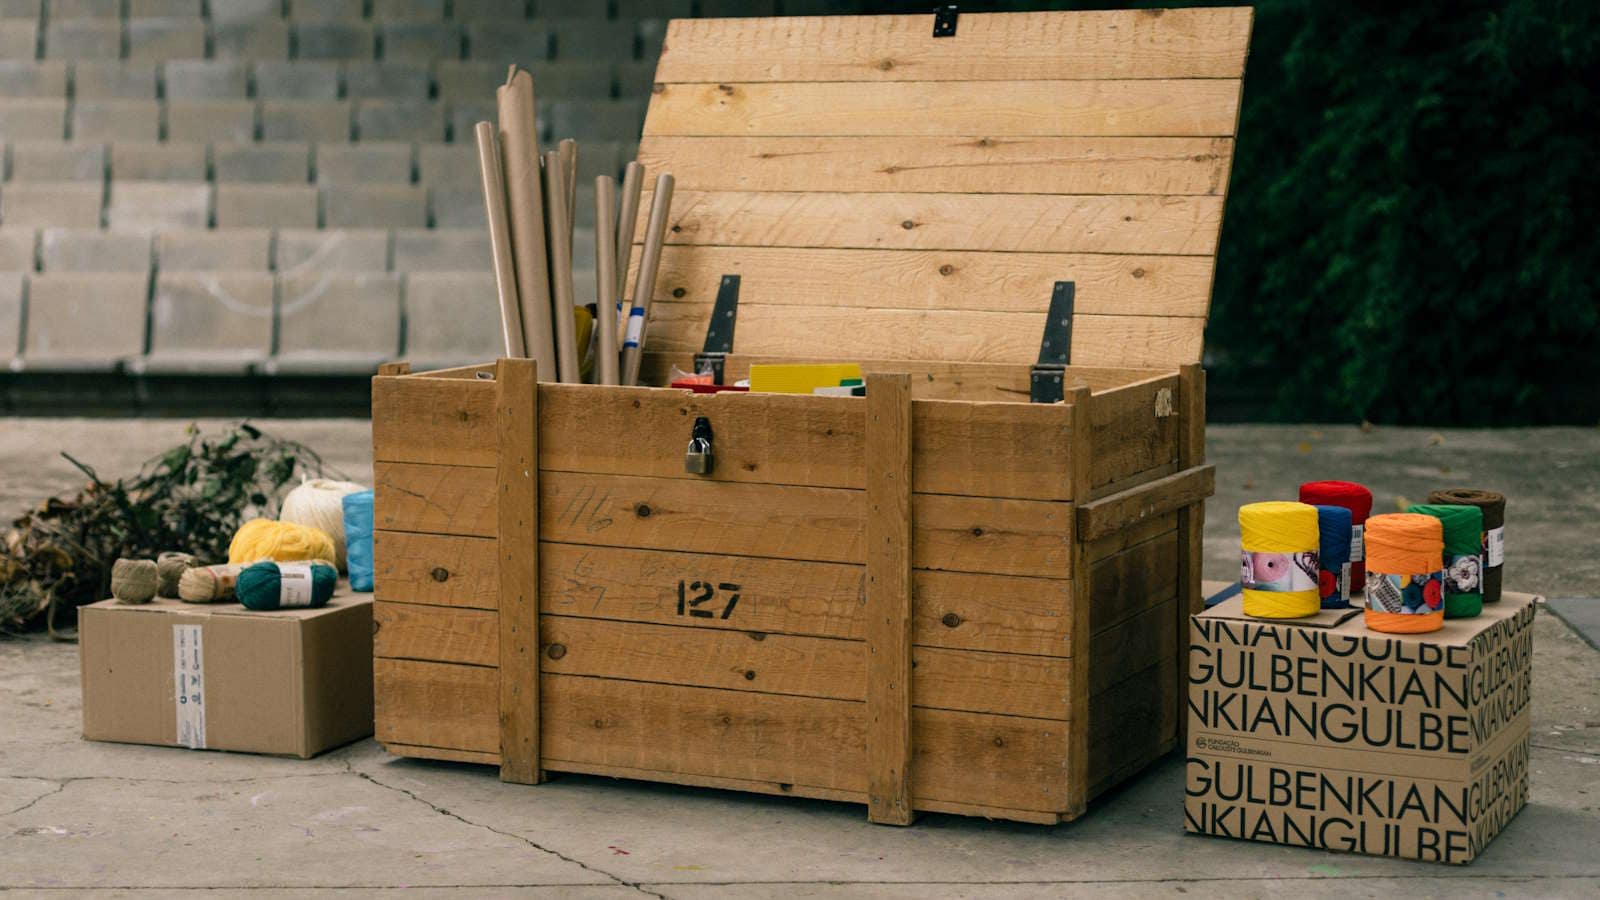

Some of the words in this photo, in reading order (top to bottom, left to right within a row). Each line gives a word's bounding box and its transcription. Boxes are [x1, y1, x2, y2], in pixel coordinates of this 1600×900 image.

[676, 579, 743, 620] 127
[1188, 644, 1469, 710] GULBENKIAN
[1185, 757, 1468, 826] GULBENKIAN
